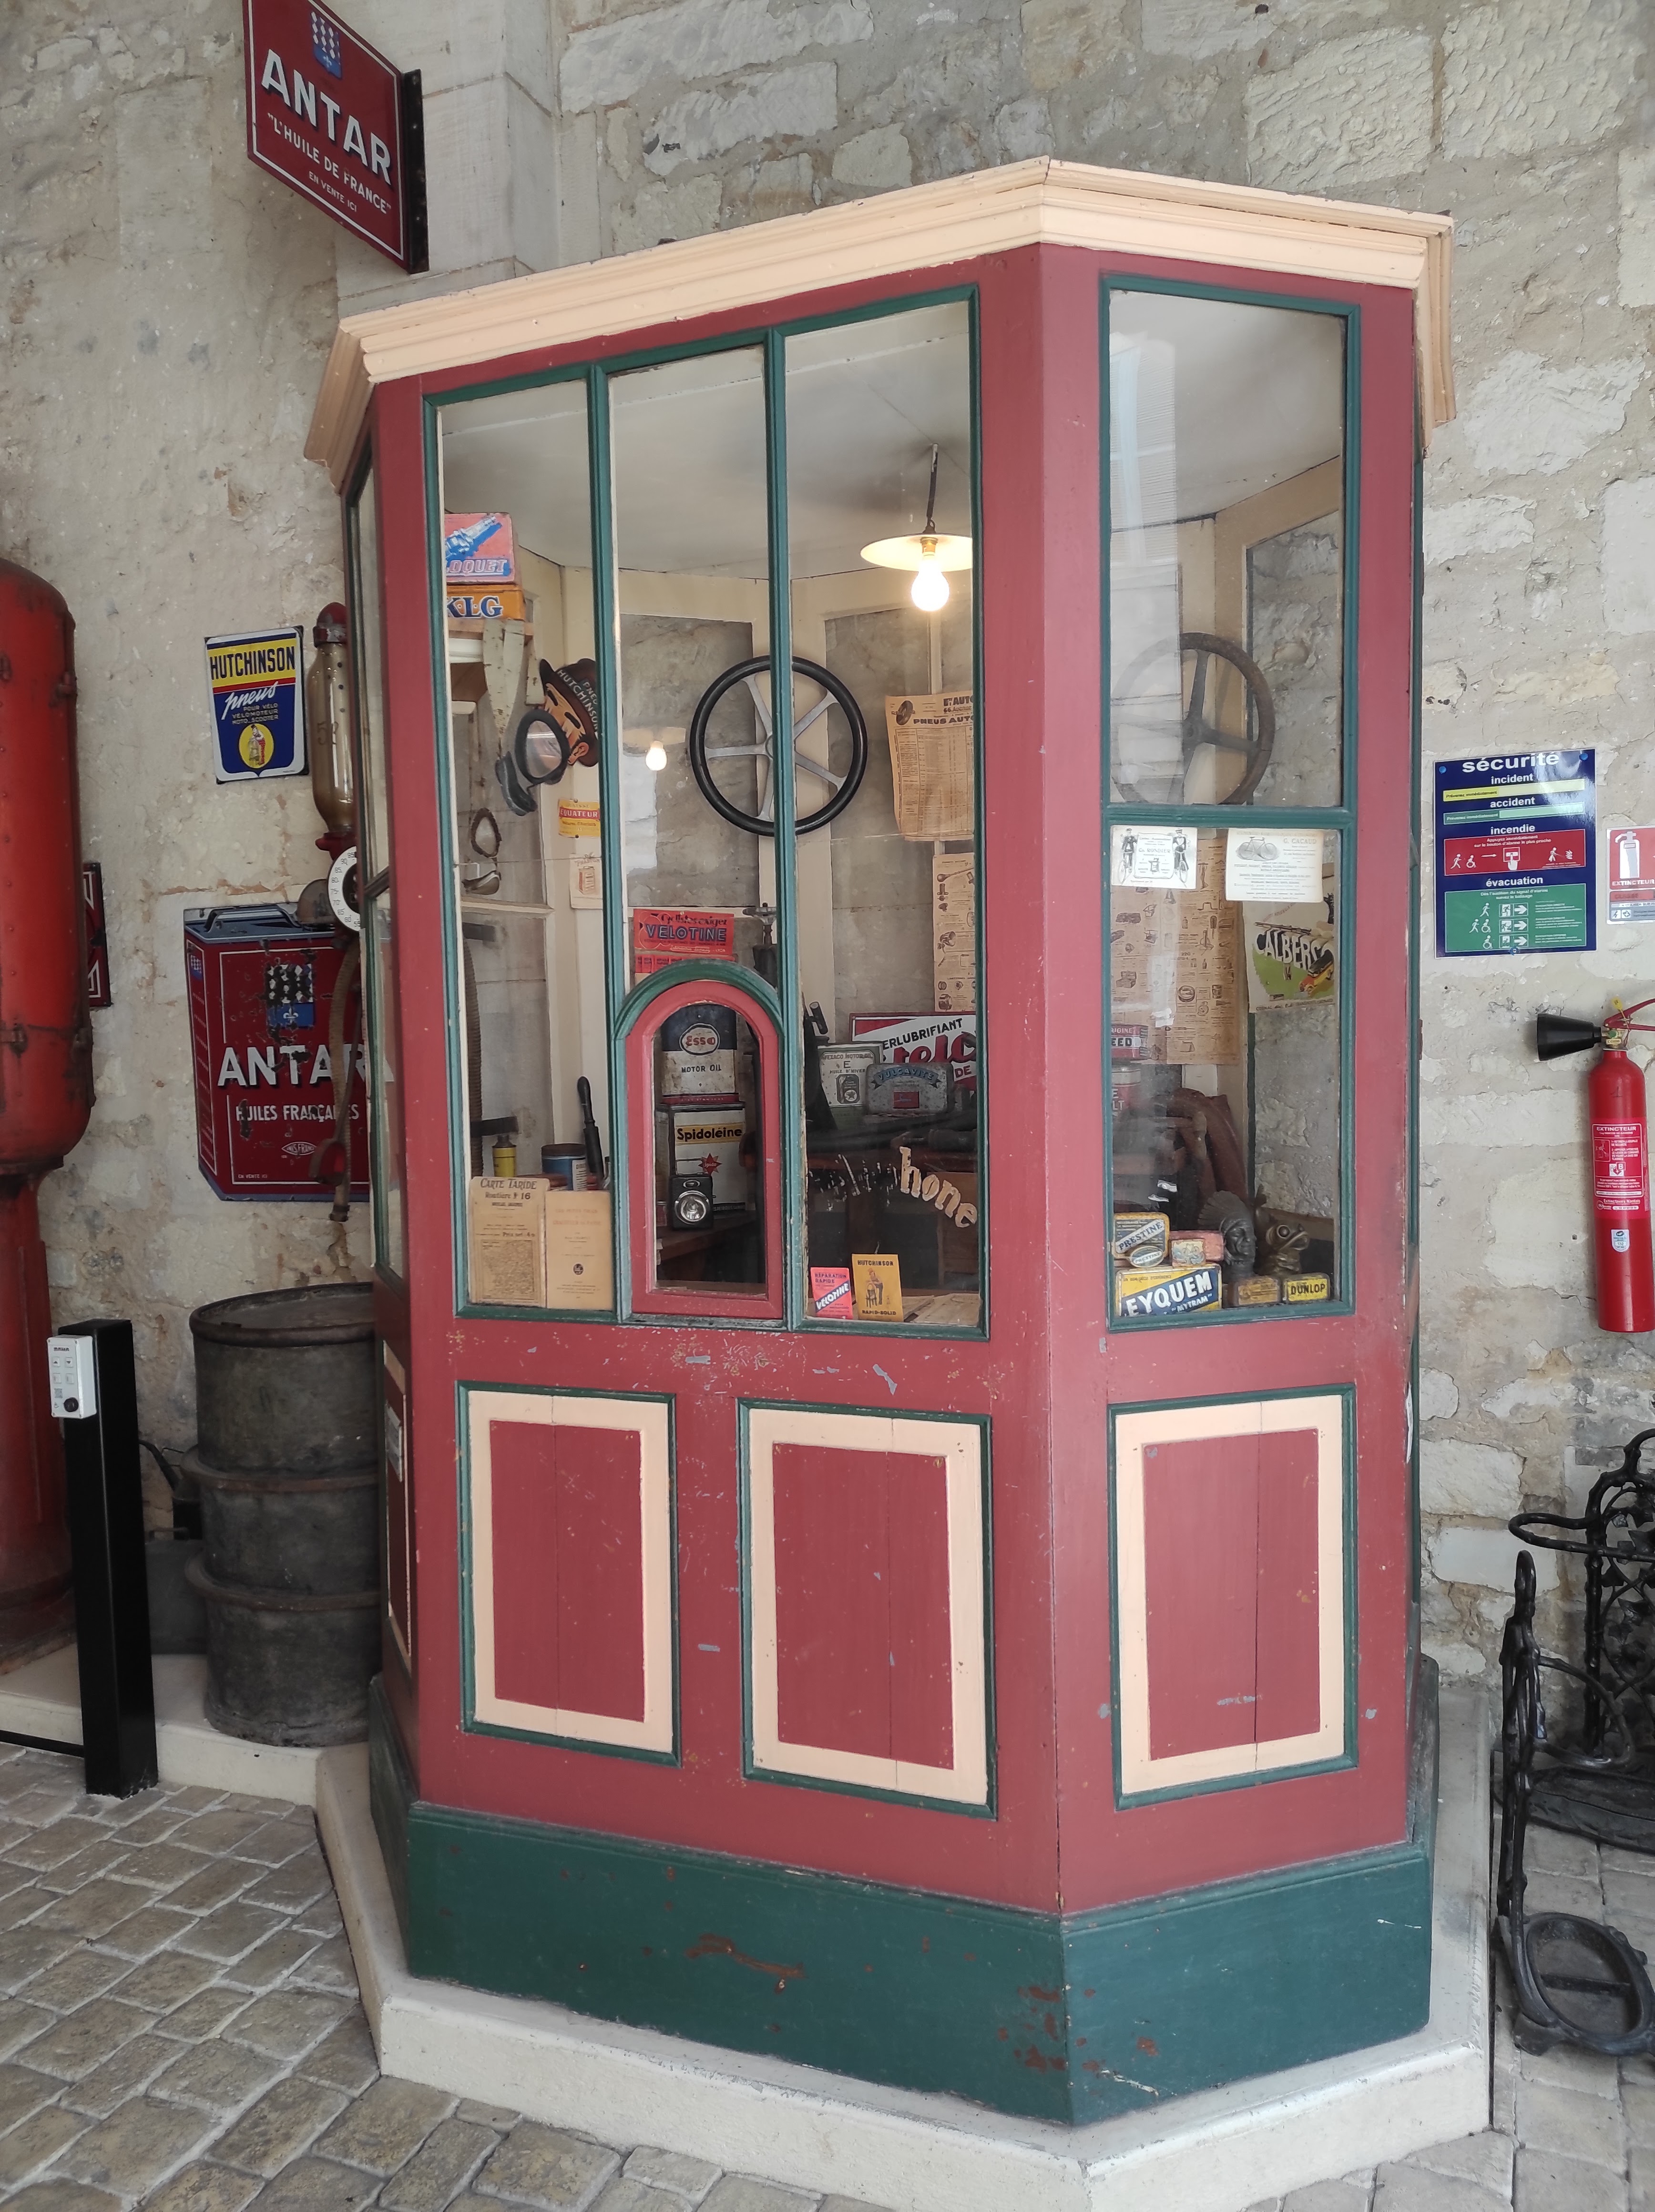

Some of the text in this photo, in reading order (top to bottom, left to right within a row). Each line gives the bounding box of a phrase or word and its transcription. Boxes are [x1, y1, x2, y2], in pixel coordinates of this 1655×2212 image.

[262, 49, 391, 185] ANTAR
[324, 156, 338, 178] DE
[309, 171, 357, 213] EN VENTE ICI
[209, 646, 295, 680] HUTCHINSON
[221, 681, 278, 720] pneus
[1462, 752, 1560, 773] sécurité
[1491, 773, 1533, 785] incident
[1490, 797, 1535, 808] accident
[1491, 824, 1535, 835] incendie
[1486, 876, 1543, 887] évacuation
[645, 924, 727, 942] VELOTINE
[878, 1068, 934, 1080] VULCAVITE
[954, 1065, 972, 1078] DE
[677, 1127, 742, 1142] Spidoléine
[480, 1178, 504, 1189] CARTE
[1118, 1221, 1164, 1251] PRESTINE
[816, 1283, 850, 1310] VELOTINE
[1125, 1271, 1213, 1317] EYQUEM
[1291, 1283, 1326, 1295] DUNLOP
